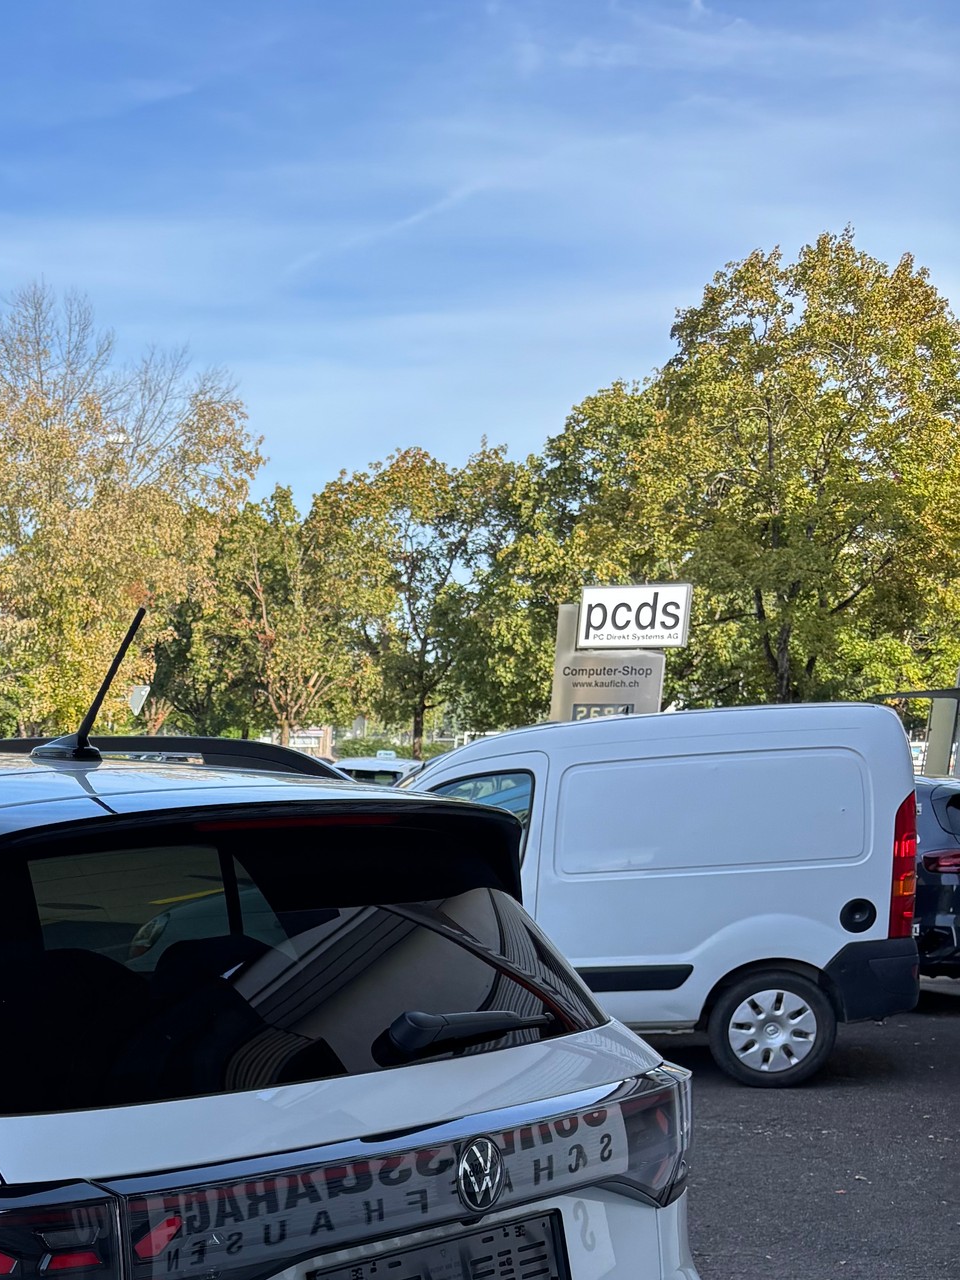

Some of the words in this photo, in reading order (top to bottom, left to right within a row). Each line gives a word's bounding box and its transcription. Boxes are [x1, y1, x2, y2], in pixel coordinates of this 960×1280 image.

[584, 592, 680, 640] pcds
[631, 633, 665, 641] Systems
[562, 666, 653, 678] Computer-Shop
